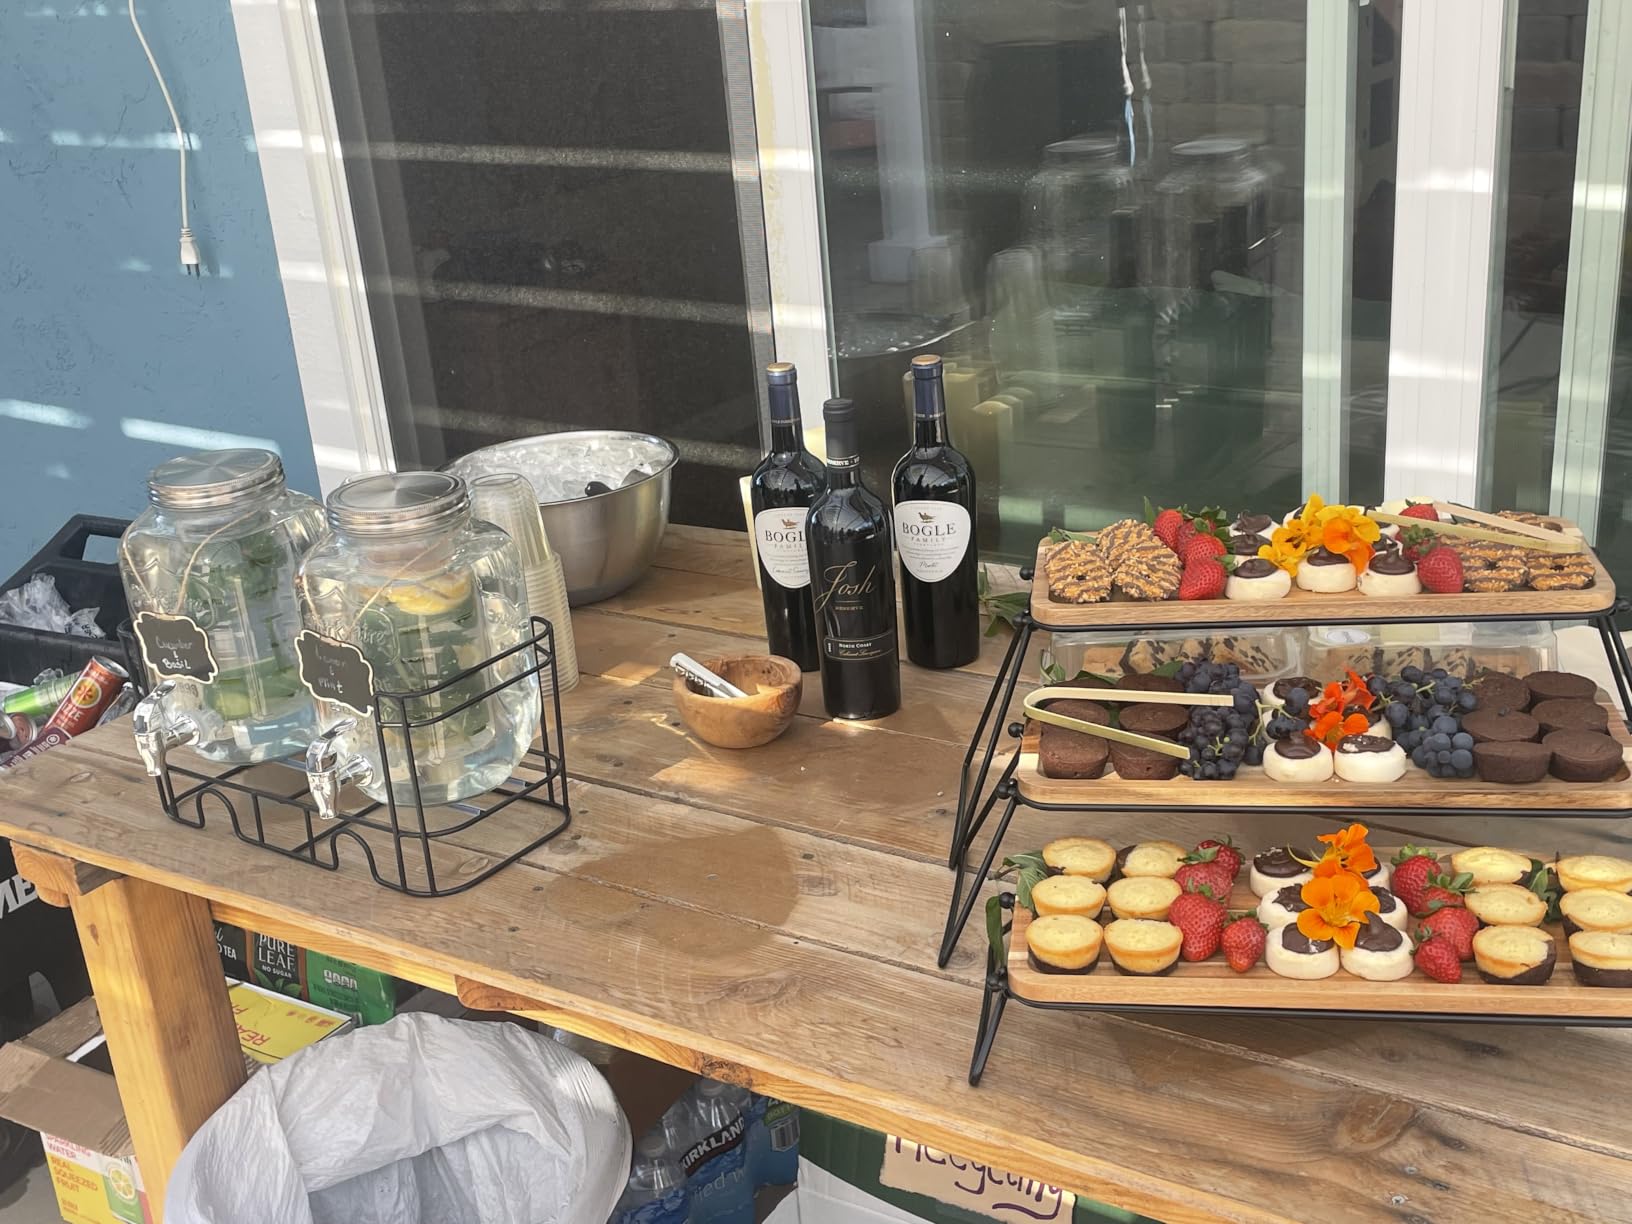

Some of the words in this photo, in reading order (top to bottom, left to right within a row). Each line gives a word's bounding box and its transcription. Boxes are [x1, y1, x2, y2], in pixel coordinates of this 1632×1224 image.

[765, 530, 806, 543] BOGL
[902, 522, 957, 537] BOGLE
[814, 560, 875, 614] Josh
[61, 702, 85, 722] IZZE
[223, 945, 237, 960] TEA
[259, 933, 297, 957] PURE
[258, 947, 296, 970] LEAF
[262, 965, 272, 973] NO
[272, 968, 292, 978] SUGAR
[236, 1024, 271, 1046] REA
[681, 1116, 746, 1169] KIRKLAND
